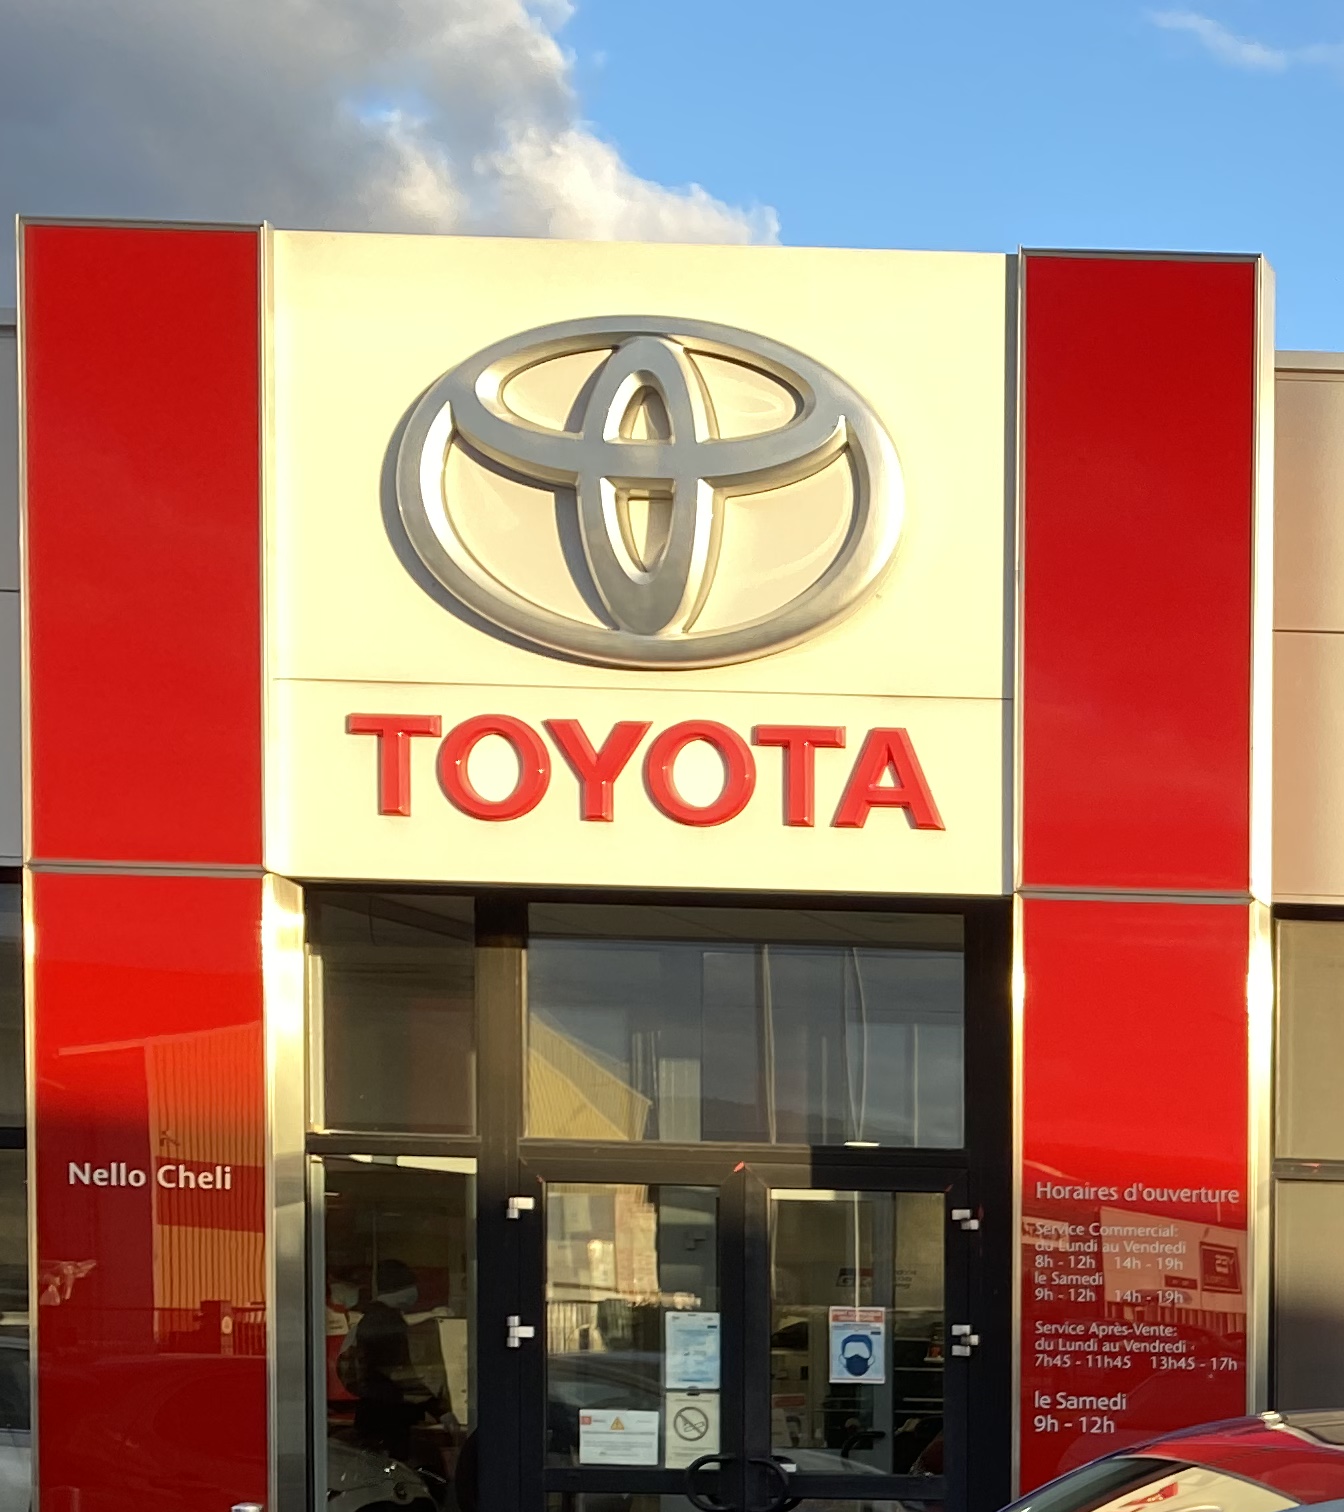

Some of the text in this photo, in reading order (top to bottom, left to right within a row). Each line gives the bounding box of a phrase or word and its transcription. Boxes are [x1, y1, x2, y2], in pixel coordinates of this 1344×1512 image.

[346, 714, 944, 829] TOYOTA
[68, 1161, 232, 1191] Nello Cheli
[1036, 1182, 1240, 1203] Horaires d'ouverture
[1035, 1223, 1084, 1236] Service
[1089, 1223, 1179, 1237] Commercial:
[1035, 1239, 1186, 1254] du Lundi au Vendredi
[1034, 1255, 1053, 1268] 8h
[1069, 1256, 1095, 1269] 12h
[1115, 1257, 1141, 1270] 14h
[1157, 1257, 1183, 1270] 19h
[1034, 1272, 1103, 1285] le Samedi
[1034, 1289, 1053, 1301] 9h
[1069, 1289, 1095, 1302] 12h
[1115, 1290, 1141, 1303] 14h
[1157, 1290, 1183, 1304] 19h
[1034, 1322, 1177, 1338] Service Après-Vente:
[1035, 1339, 1186, 1353] du Lundi au Vendredi
[1034, 1354, 1071, 1367] 7h45
[1087, 1355, 1131, 1368] 11h45
[1150, 1356, 1195, 1370] 13h45
[1210, 1357, 1238, 1371] 17h
[1034, 1391, 1127, 1411] le Samedi
[1034, 1415, 1058, 1432] 9h
[1079, 1417, 1115, 1433] 12h
